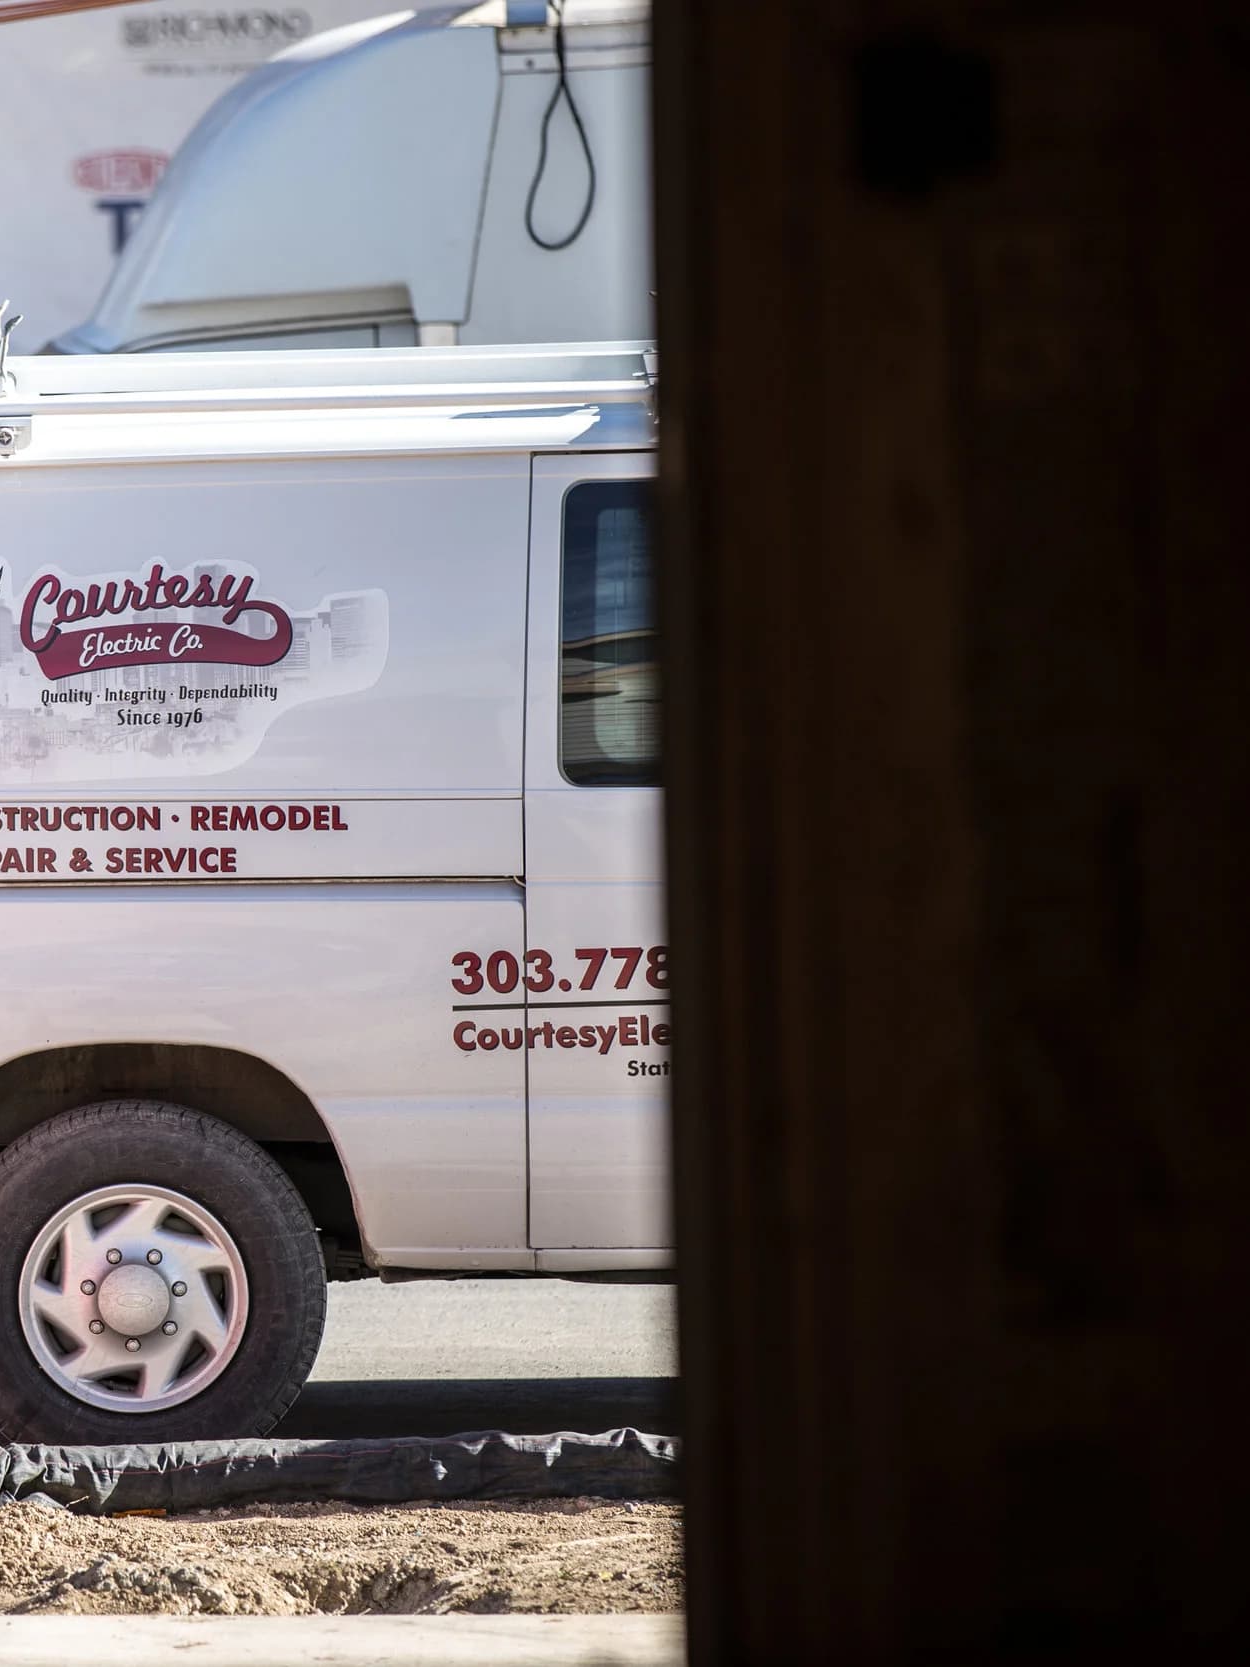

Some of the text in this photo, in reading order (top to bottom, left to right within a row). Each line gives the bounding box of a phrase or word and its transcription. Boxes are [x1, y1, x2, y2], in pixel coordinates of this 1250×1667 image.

[20, 564, 254, 653] Courtesy
[78, 624, 204, 668] Electric Co.
[41, 683, 279, 706] Quality Integrity Dependability
[117, 708, 204, 728] Since 1976
[190, 804, 349, 832] REMODEL
[68, 847, 95, 874] &
[105, 846, 238, 874] SERVICE
[451, 945, 671, 996] 303.778
